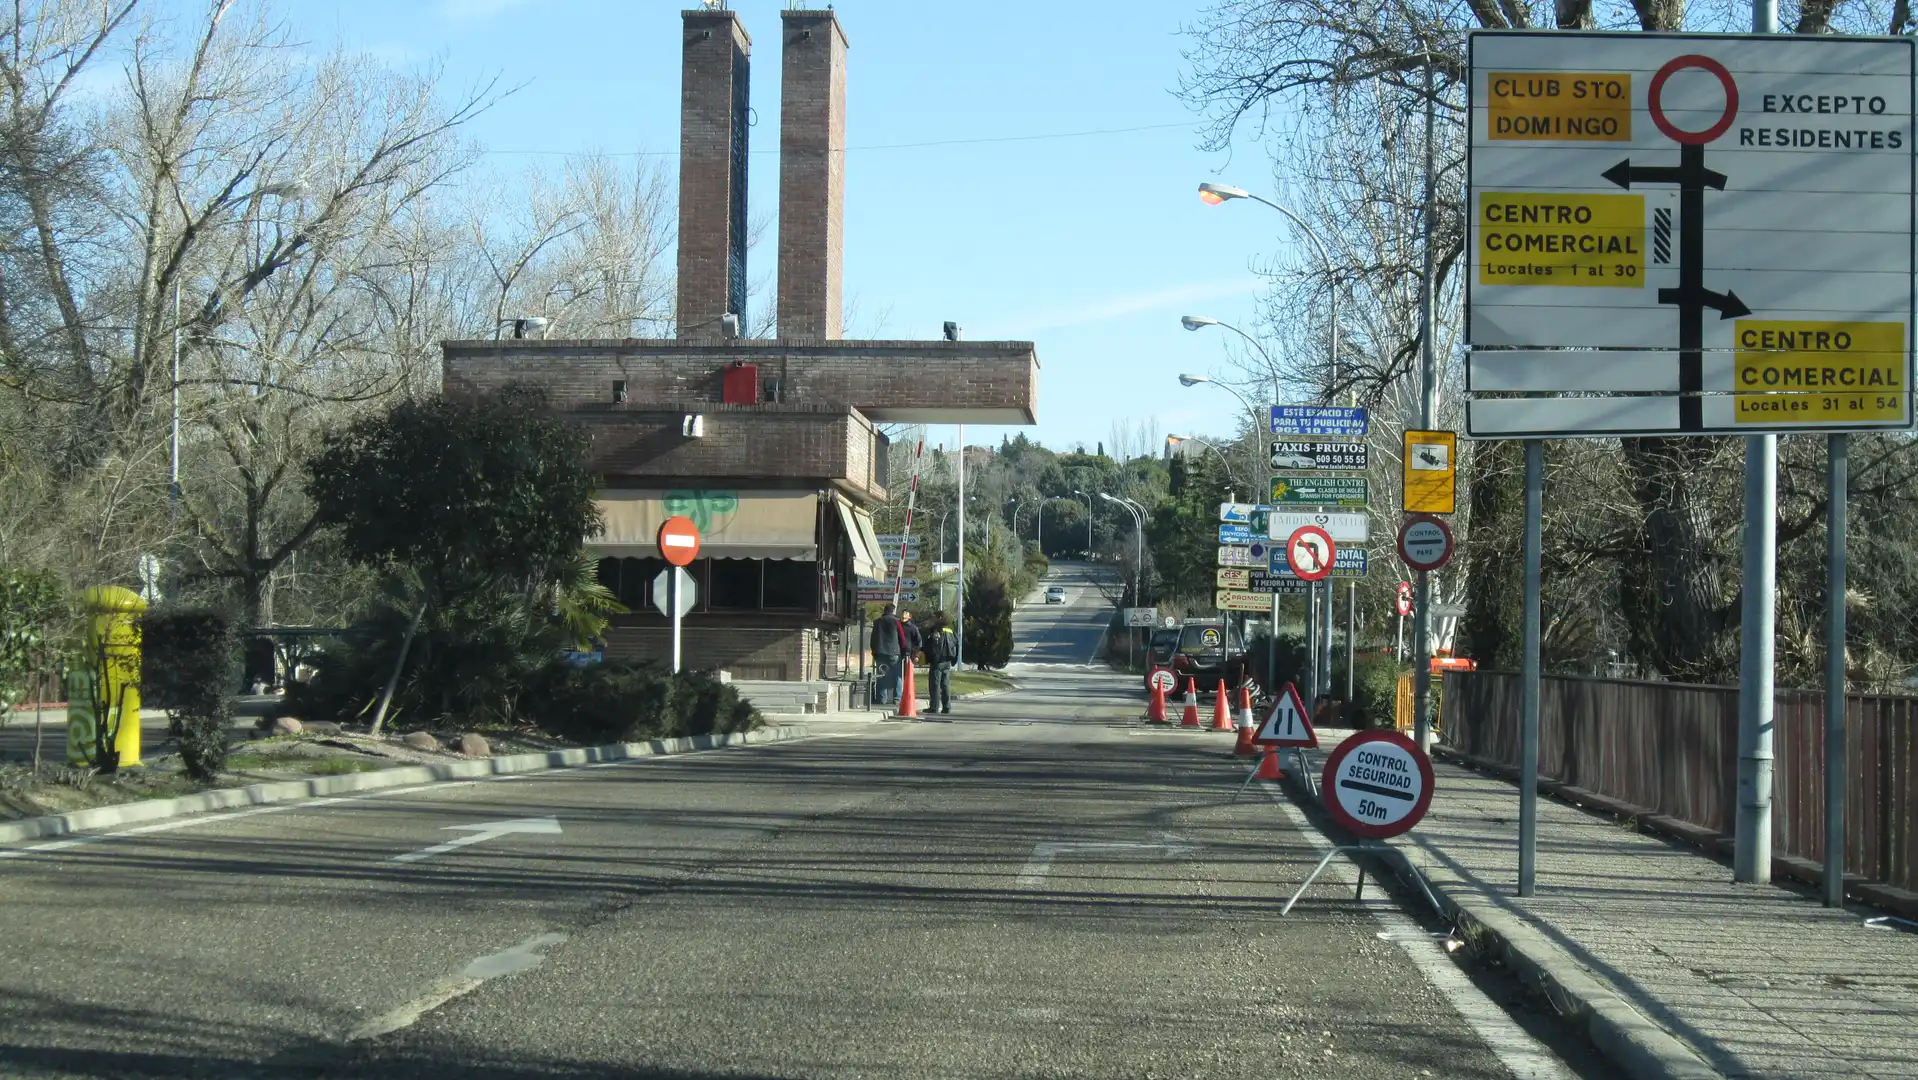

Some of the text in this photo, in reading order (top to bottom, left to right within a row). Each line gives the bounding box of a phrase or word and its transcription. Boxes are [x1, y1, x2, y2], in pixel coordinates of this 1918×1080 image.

[1494, 78, 1626, 100] CLUB STO.
[1763, 94, 1886, 115] EXCEPTO
[1496, 116, 1618, 135] DOMINGO
[1740, 127, 1903, 149] RESIDENTES
[1485, 204, 1592, 225] CENTRO
[1485, 233, 1638, 255] COMERCIAL
[1487, 262, 1637, 277] Locales 1 al 30
[1741, 329, 1851, 350] CENTRO
[1741, 367, 1899, 386] COMERCIAL
[1283, 408, 1354, 417] ESTE ESPACIO ES
[1740, 397, 1898, 412] Locales 31 al 54
[1273, 418, 1297, 426] PARA
[1273, 443, 1366, 453] TAXIS-FRUTOS
[1316, 454, 1366, 464] 609 50 55 55
[1289, 478, 1366, 487] THE ENGLISH CENTRE
[1336, 549, 1364, 560] ENTAL
[1254, 579, 1259, 587] Y
[1260, 579, 1286, 587] MEJORA
[1357, 751, 1408, 773] CONTROL
[1349, 765, 1411, 789] SEGURIDAD
[1358, 799, 1387, 820] 50m
